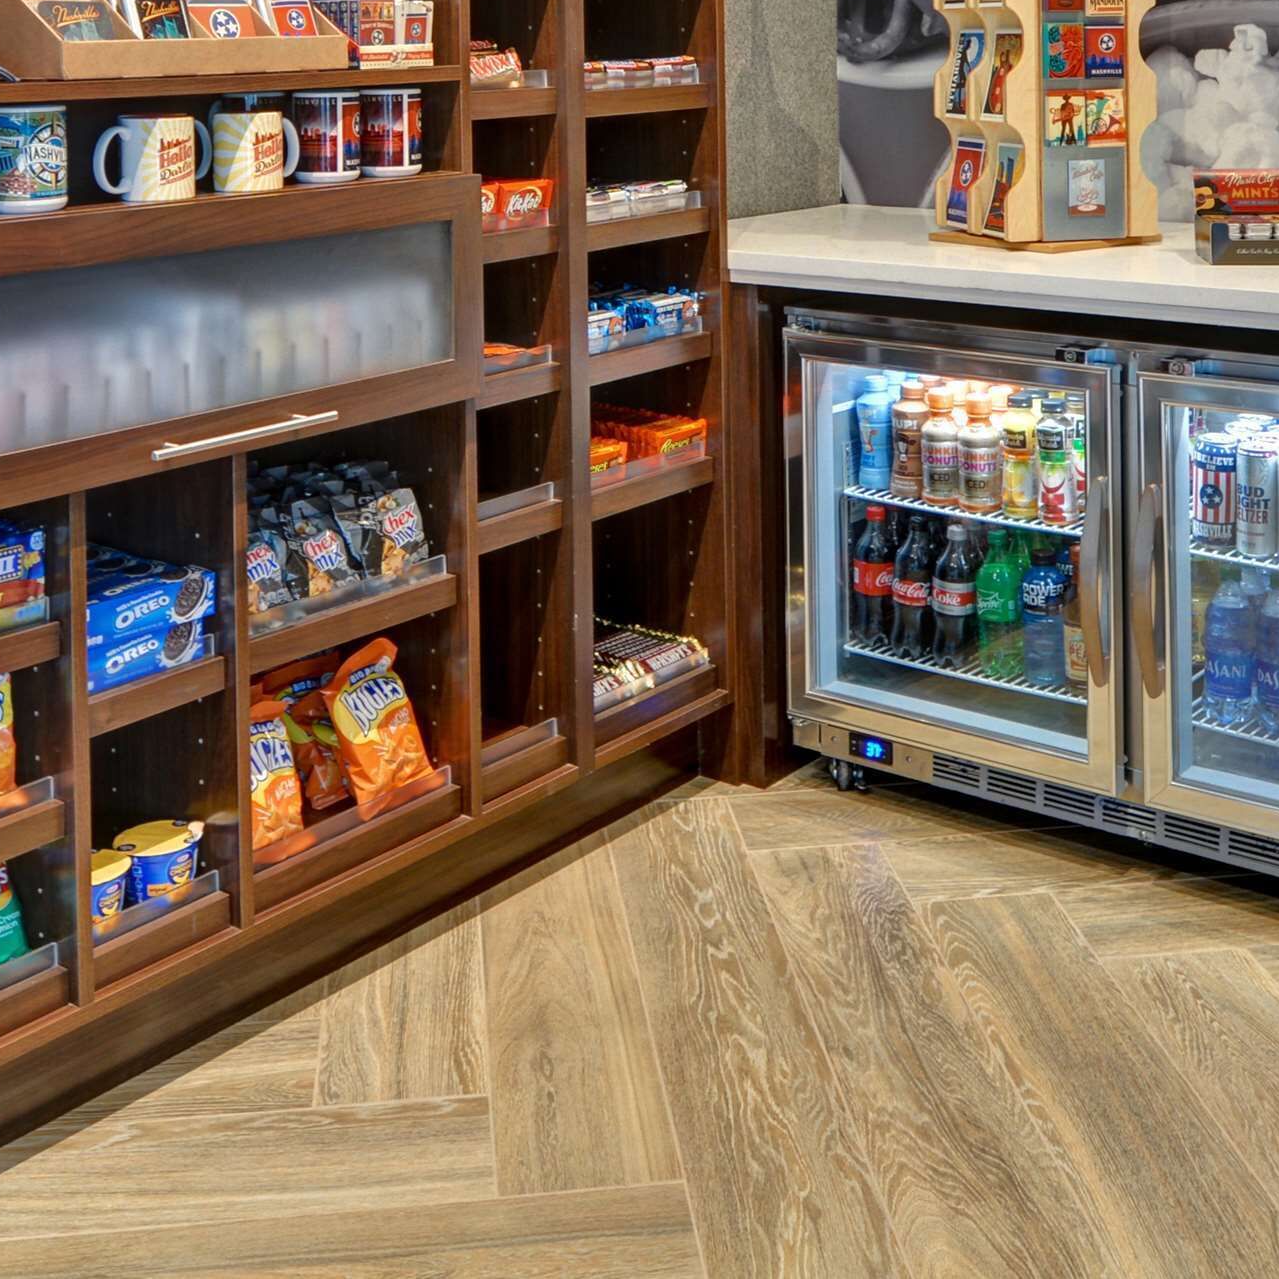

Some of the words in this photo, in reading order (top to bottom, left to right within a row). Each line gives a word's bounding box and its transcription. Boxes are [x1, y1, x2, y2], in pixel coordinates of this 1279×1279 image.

[160, 144, 192, 167] Hello
[254, 141, 282, 161] Hello
[1258, 172, 1277, 187] City
[1232, 188, 1279, 199] MINTS
[1238, 484, 1264, 497] BUD
[384, 509, 416, 534] Chex
[394, 522, 417, 545] mix
[303, 532, 337, 558] Chex
[315, 548, 344, 570] mix
[892, 582, 930, 597] Coca-Cola
[1023, 582, 1063, 596] POWER
[933, 593, 961, 606] Coke
[977, 598, 1001, 610] Sprite
[114, 594, 170, 629] OREO
[105, 639, 159, 674] OREO
